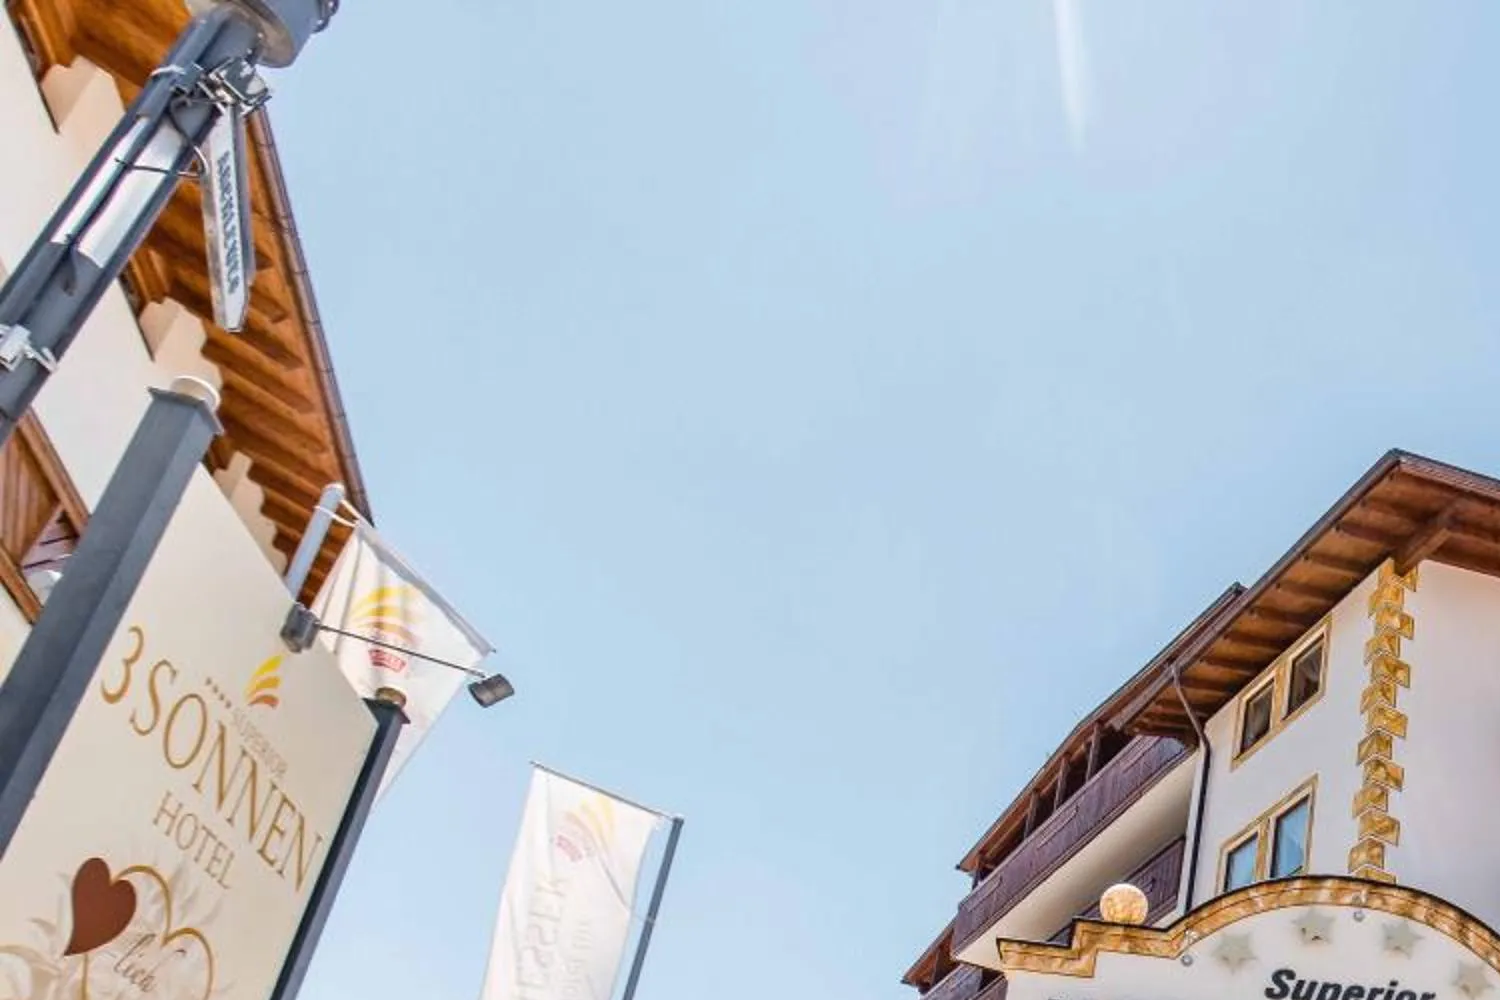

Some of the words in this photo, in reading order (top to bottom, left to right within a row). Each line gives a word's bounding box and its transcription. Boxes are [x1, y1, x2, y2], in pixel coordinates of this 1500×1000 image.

[101, 625, 144, 704] 3
[129, 659, 323, 892] SONNEN
[152, 790, 235, 890] HOTEL
